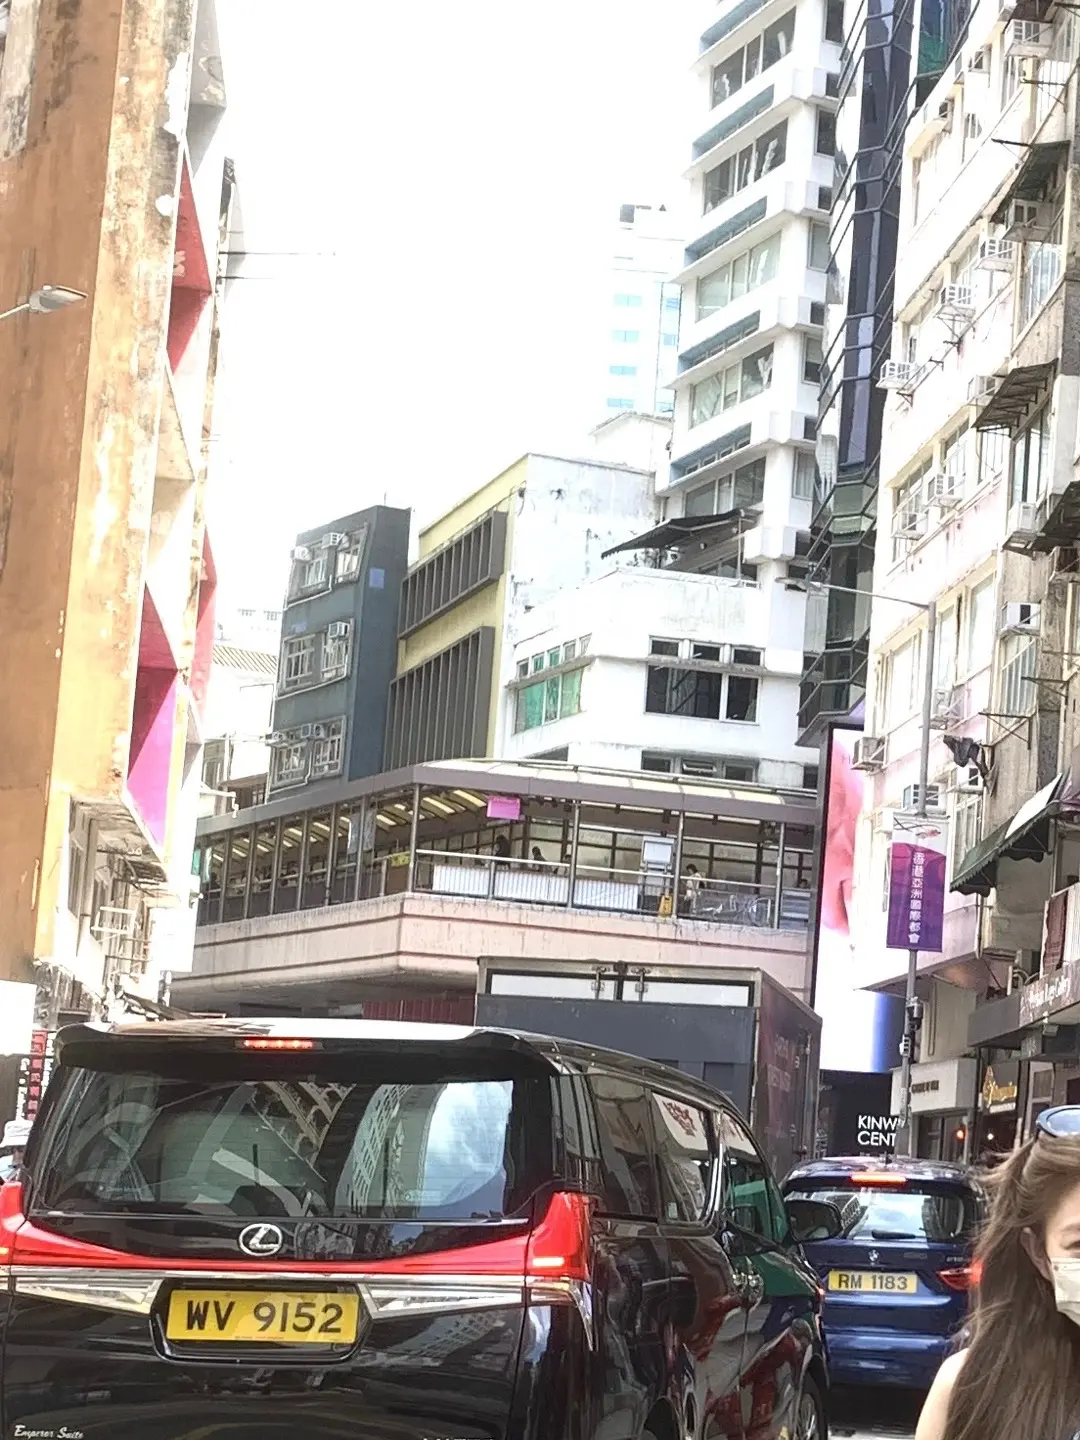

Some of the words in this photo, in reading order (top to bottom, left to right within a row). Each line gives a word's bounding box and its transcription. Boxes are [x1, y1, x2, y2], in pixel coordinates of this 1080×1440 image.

[838, 1273, 862, 1289] RM
[871, 1275, 908, 1290] 1183
[186, 1300, 236, 1331] WV
[253, 1302, 344, 1333] 9152
[14, 1424, 55, 1439] Emperor
[57, 1426, 84, 1439] Suite
